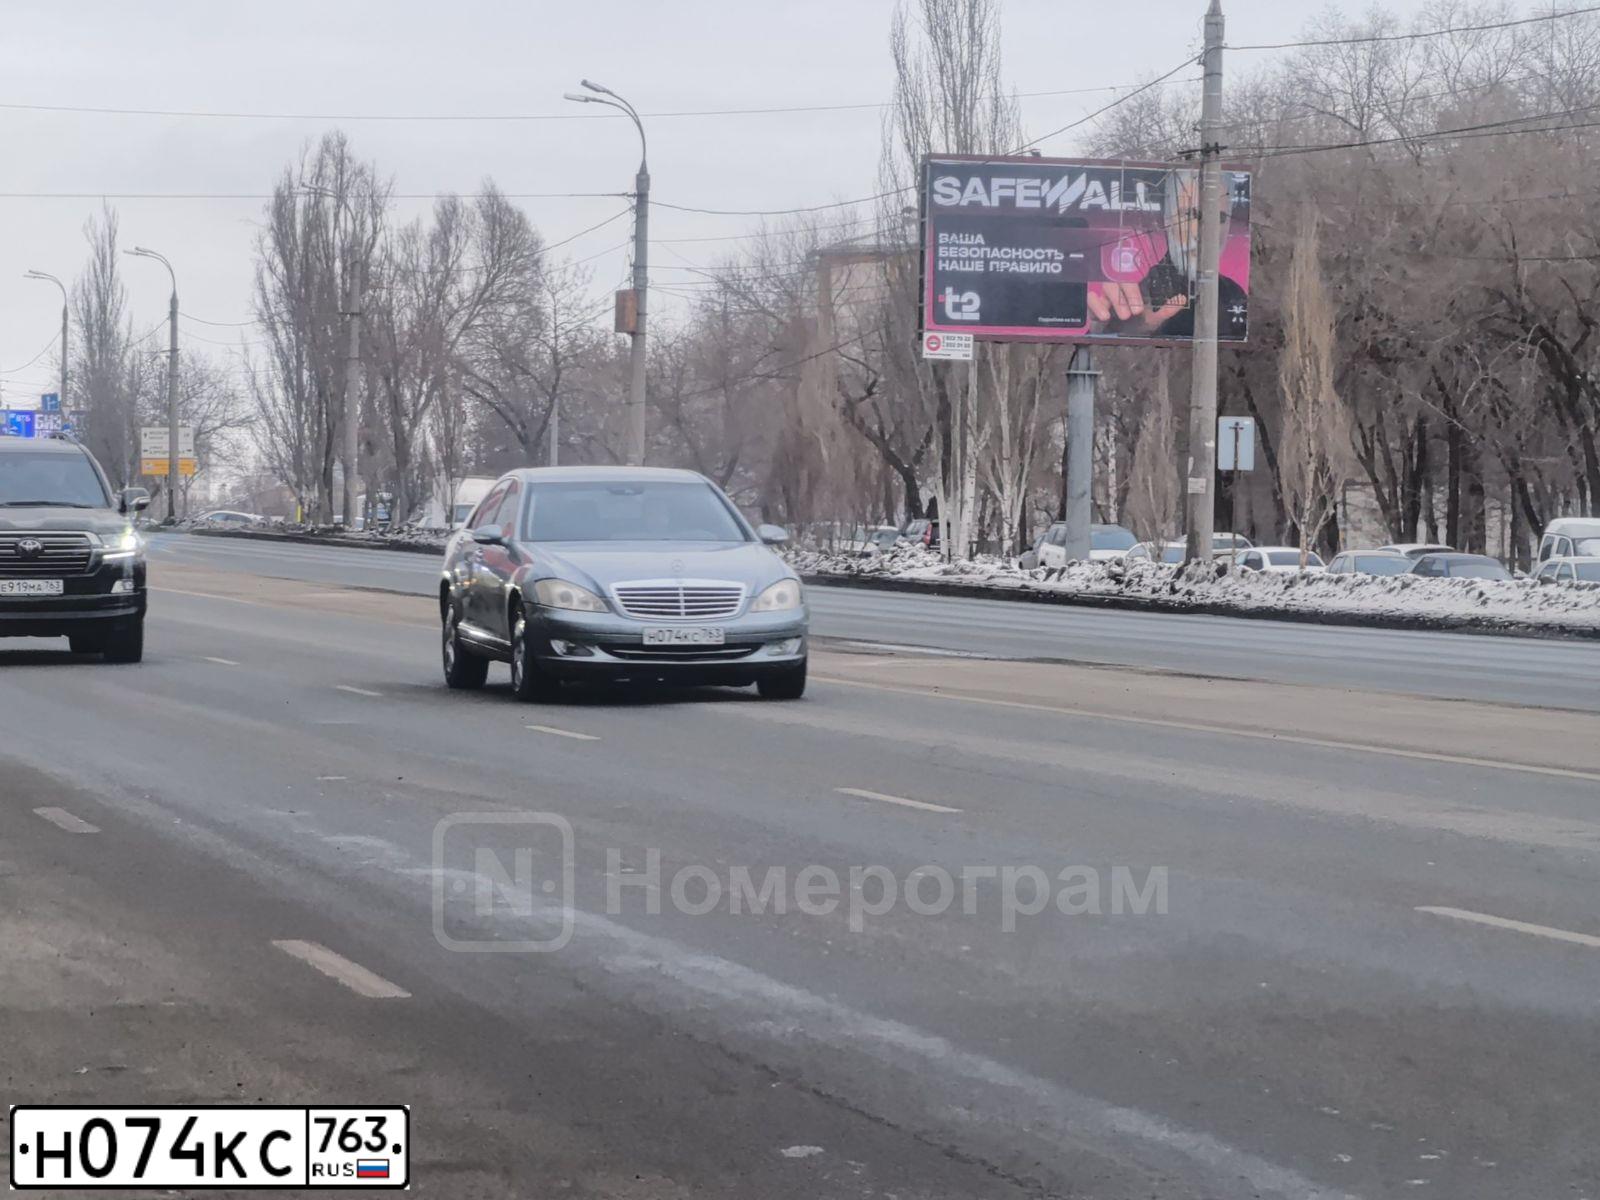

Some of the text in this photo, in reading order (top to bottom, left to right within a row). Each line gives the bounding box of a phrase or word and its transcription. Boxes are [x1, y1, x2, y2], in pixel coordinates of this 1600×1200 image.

[938, 232, 985, 246] ВАША
[938, 246, 1065, 261] БЕЗОПАСНОСТЬ
[938, 259, 1063, 274] НАШЕ ПРАВИЛО
